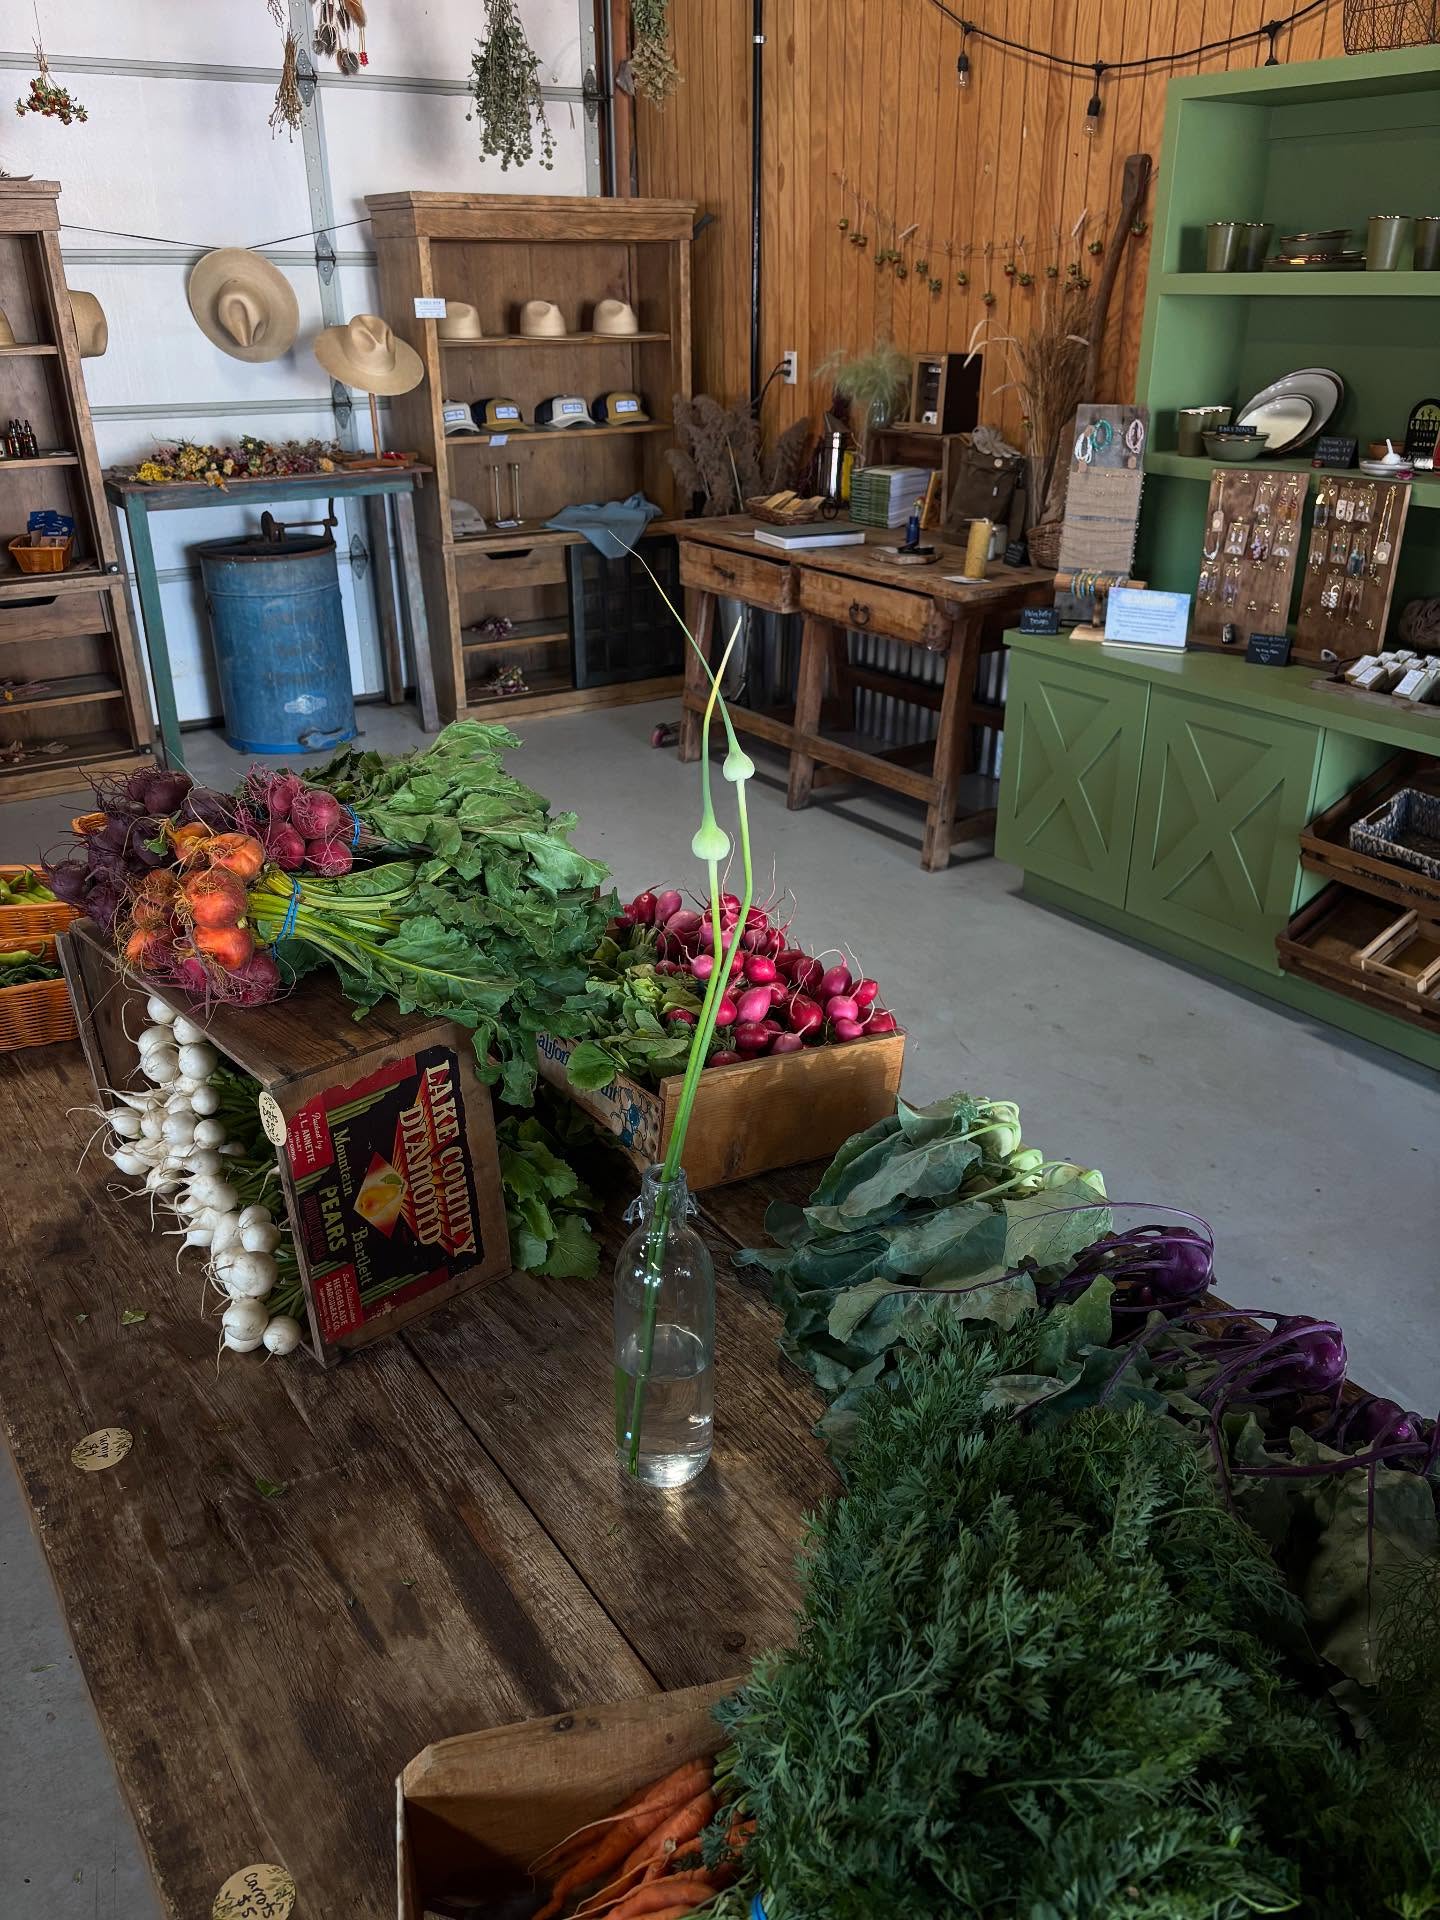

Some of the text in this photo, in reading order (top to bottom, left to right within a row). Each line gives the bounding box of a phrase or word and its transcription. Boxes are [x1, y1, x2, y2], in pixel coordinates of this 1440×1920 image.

[537, 1033, 571, 1066] alifor
[302, 1129, 315, 1164] ANNETTE
[333, 1127, 352, 1197] Mountain
[399, 1101, 442, 1245] DIAMOND
[426, 1059, 477, 1257] LAKE COUNTY
[319, 1185, 347, 1252] PEARS
[352, 1226, 374, 1286] Bartlett
[333, 1277, 348, 1327] HEGGBLADE
[244, 1872, 275, 1919] Carrots
